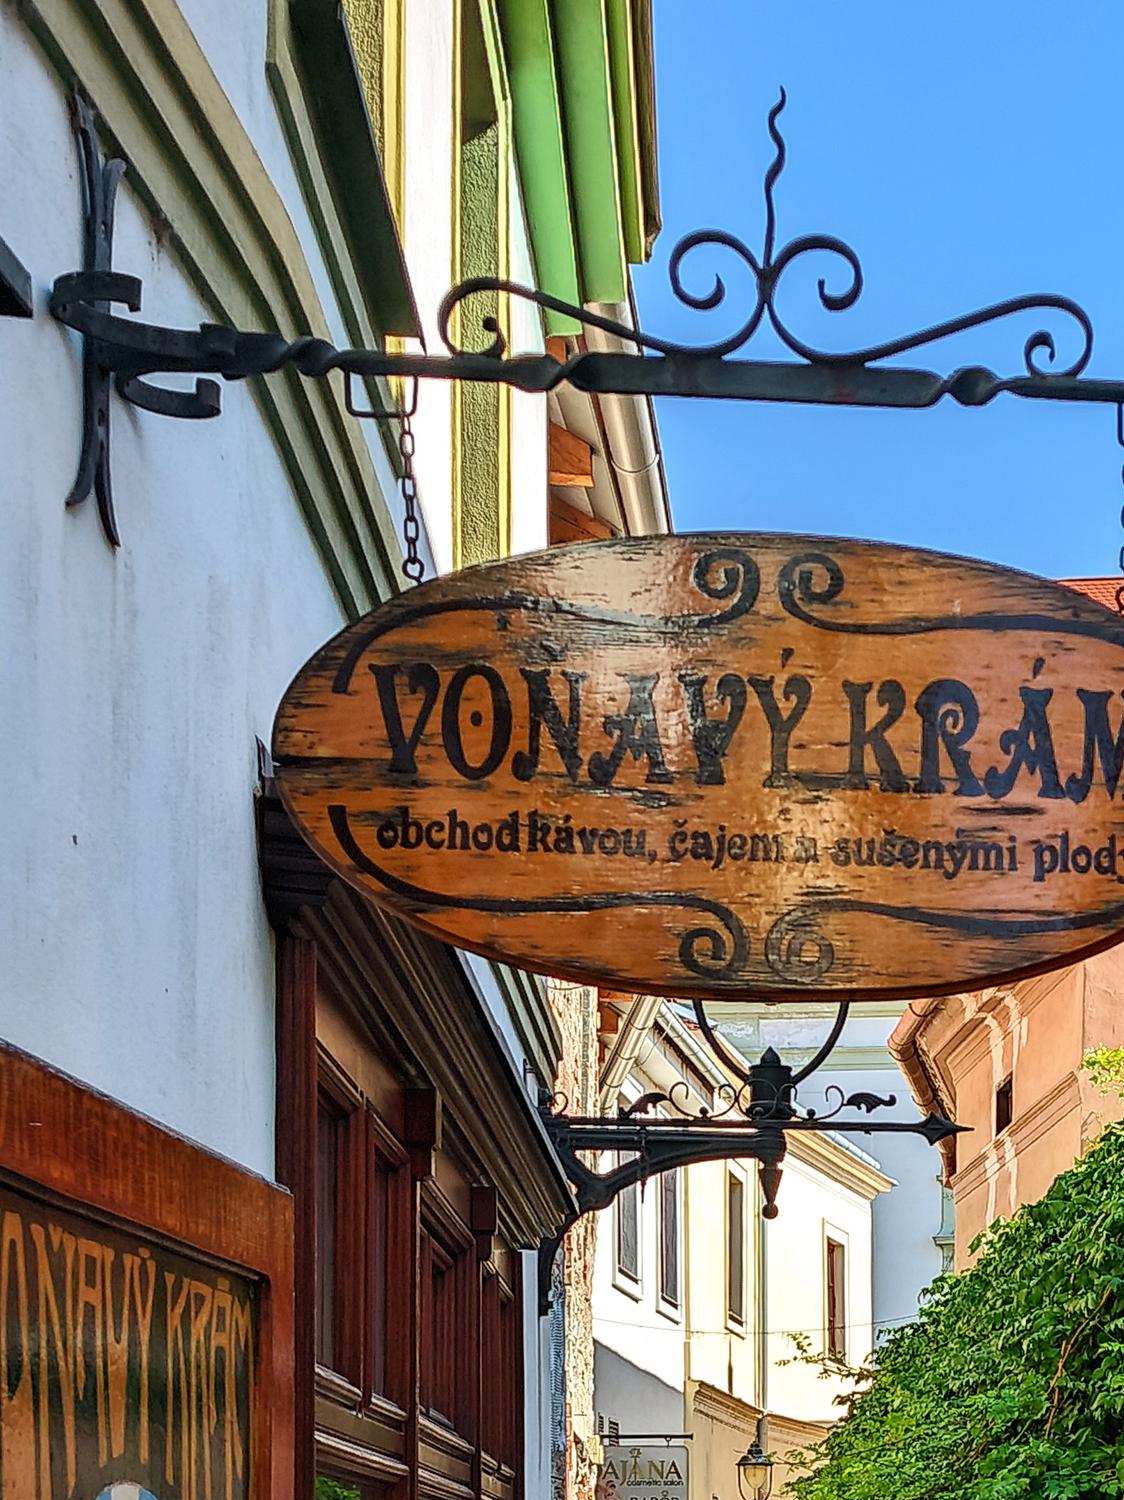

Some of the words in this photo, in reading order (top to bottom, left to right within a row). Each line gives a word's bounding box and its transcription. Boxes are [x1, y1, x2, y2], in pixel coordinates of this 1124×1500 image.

[367, 647, 812, 788] VONAVÝ
[376, 806, 521, 853] obchod
[668, 818, 785, 869] čajem
[793, 835, 820, 865] a
[830, 827, 1019, 881] sušenými
